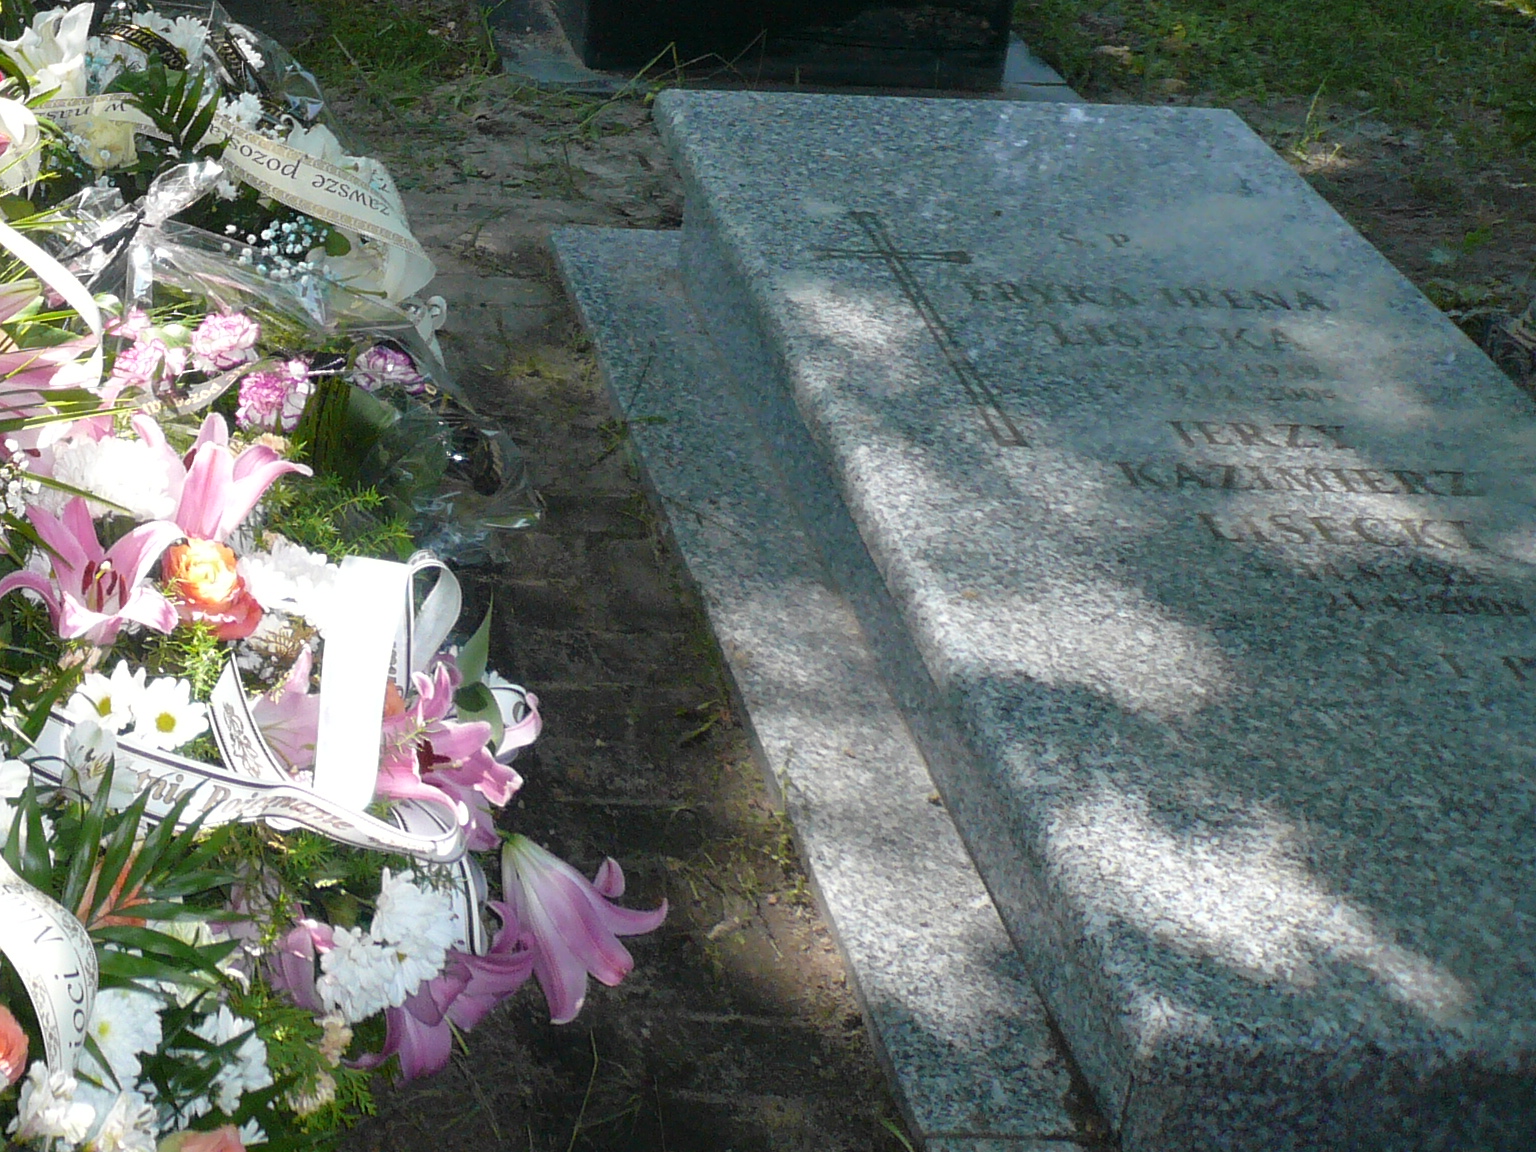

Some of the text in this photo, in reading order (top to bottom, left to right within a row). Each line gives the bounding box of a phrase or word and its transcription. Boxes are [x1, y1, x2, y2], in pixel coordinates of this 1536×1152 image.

[312, 172, 391, 217] zawsze
[1158, 286, 1333, 312] IRENA
[1165, 419, 1357, 450] JERZY
[1114, 459, 1488, 498] KAZIMIERZ
[1197, 512, 1488, 551] LISECKI
